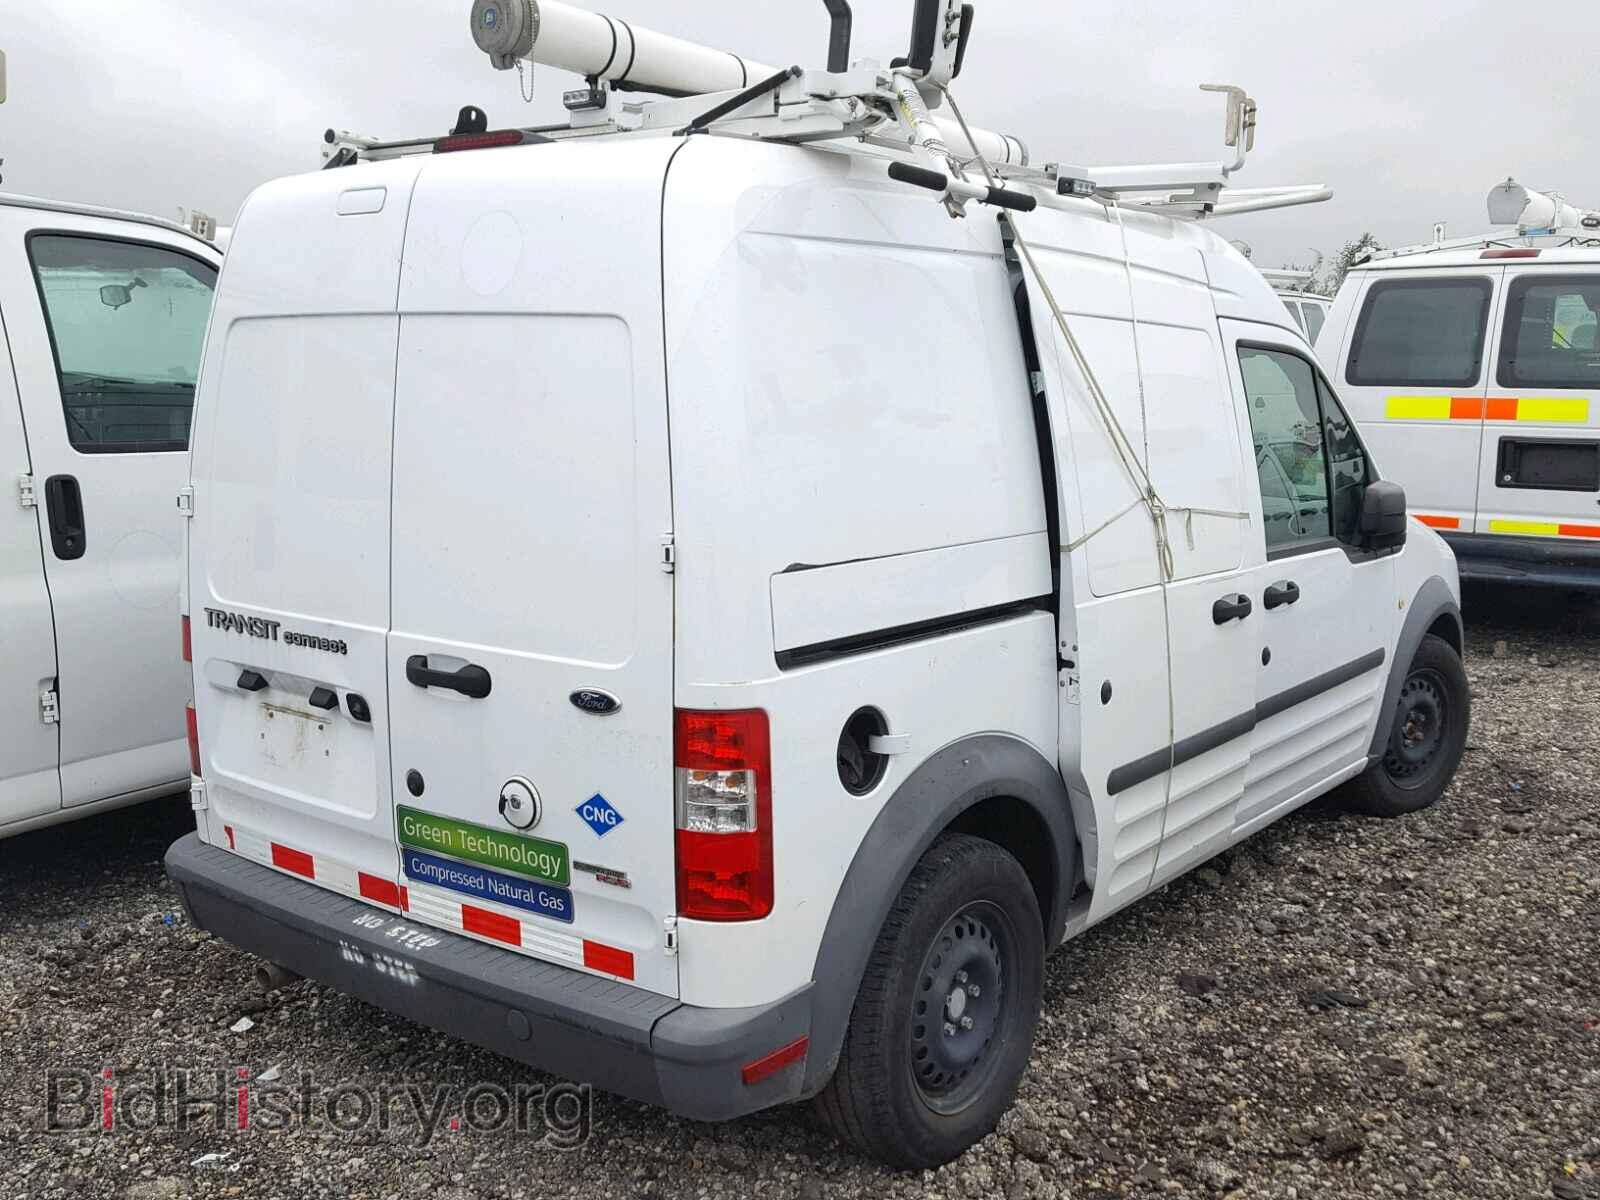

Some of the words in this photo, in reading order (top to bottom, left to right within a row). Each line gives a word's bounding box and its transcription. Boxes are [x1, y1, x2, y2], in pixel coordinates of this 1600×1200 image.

[204, 607, 280, 641] TRANSIT
[283, 630, 348, 655] connect
[582, 804, 616, 825] CNG
[403, 815, 451, 845] Green
[457, 828, 561, 878] Technology
[411, 857, 484, 890] Compressed
[488, 877, 535, 904] Natural
[538, 892, 565, 912] Gas
[352, 913, 384, 929] NO
